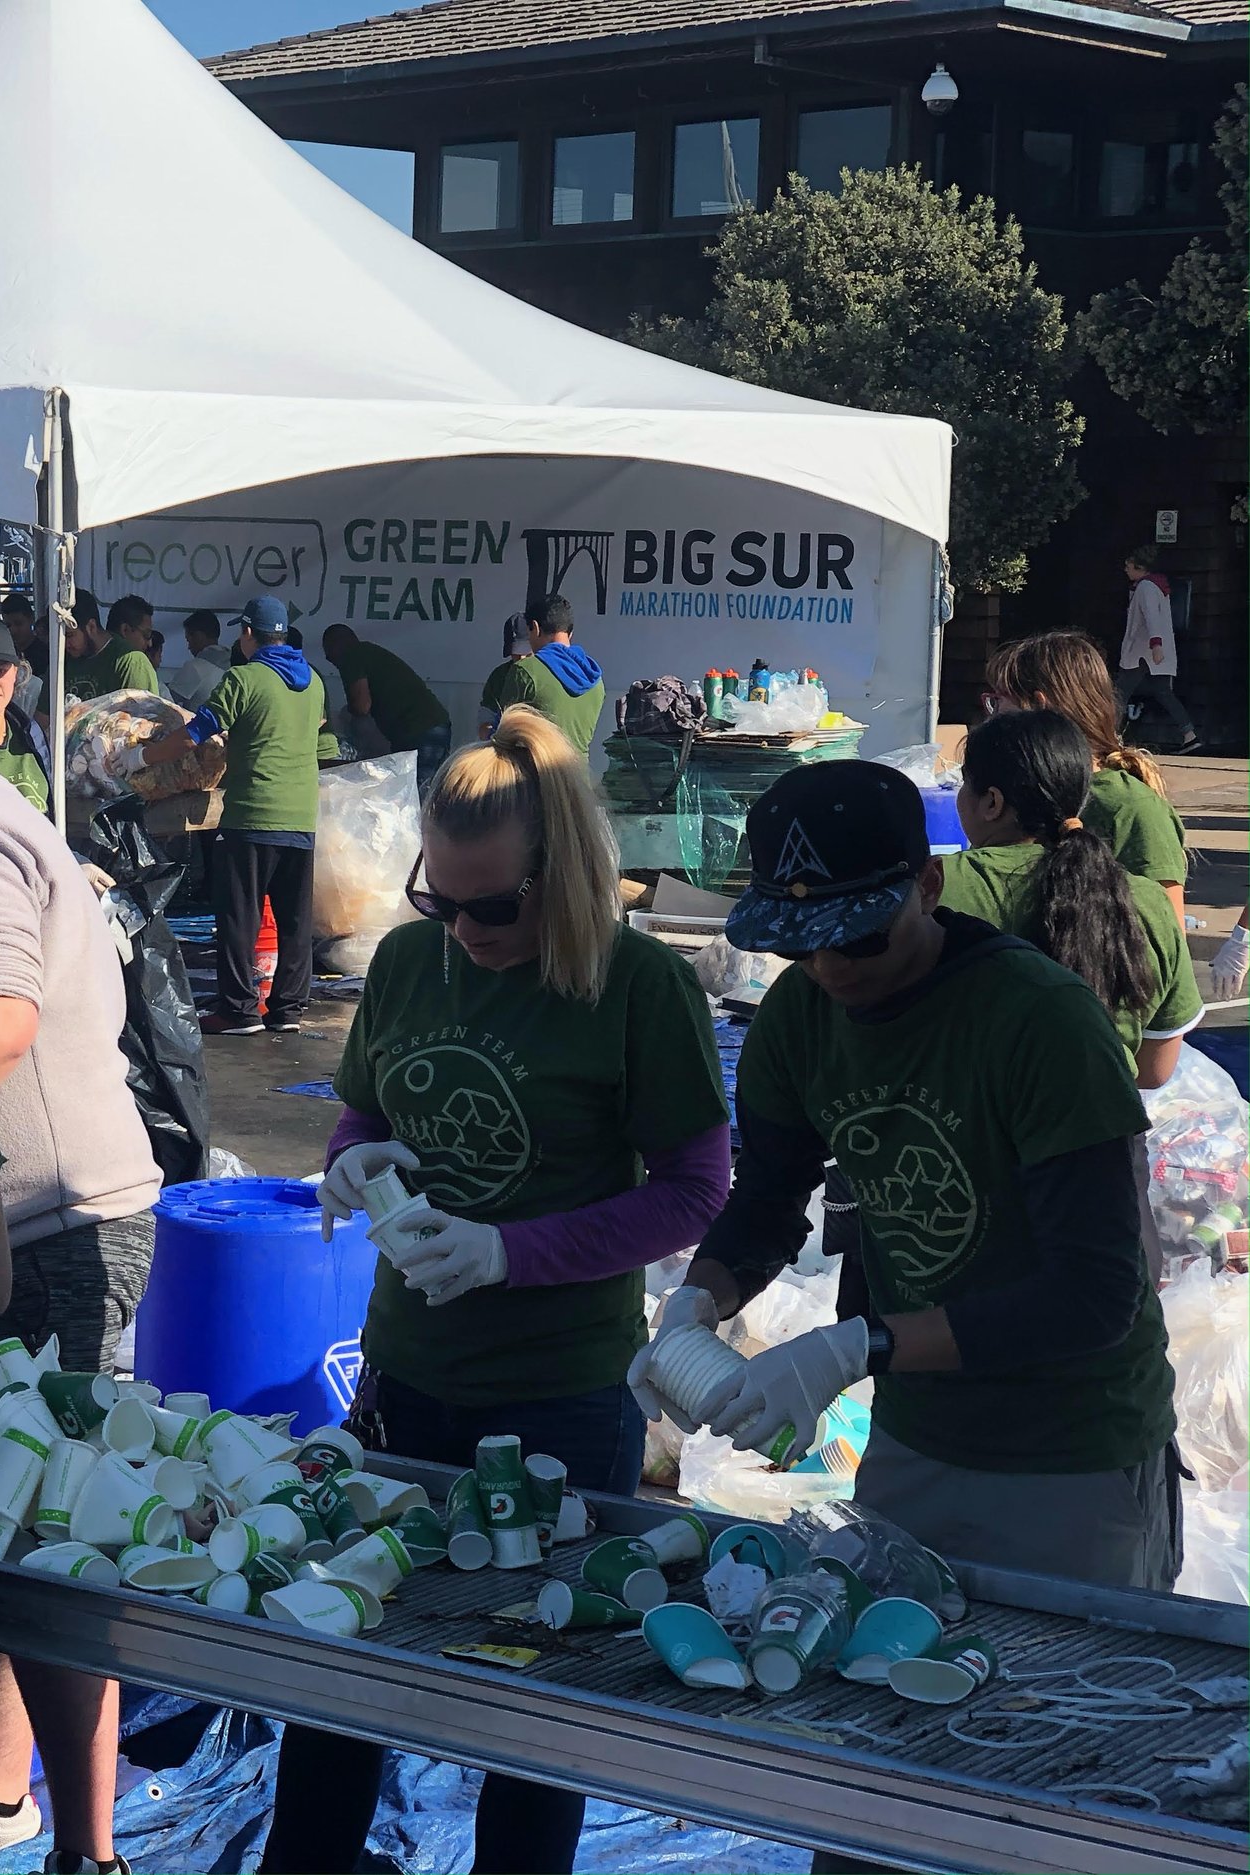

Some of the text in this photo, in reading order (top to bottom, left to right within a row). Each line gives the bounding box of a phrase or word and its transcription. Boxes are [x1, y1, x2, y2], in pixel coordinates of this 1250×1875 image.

[106, 540, 306, 587] recover
[344, 518, 510, 564] GREEN
[623, 529, 855, 590] BIG SUR
[340, 575, 475, 622] TEAM
[620, 591, 853, 624] MARATHON FOUNDATION
[391, 1025, 529, 1082] GREEN TEAM
[820, 1084, 963, 1132] GREEN TEAM
